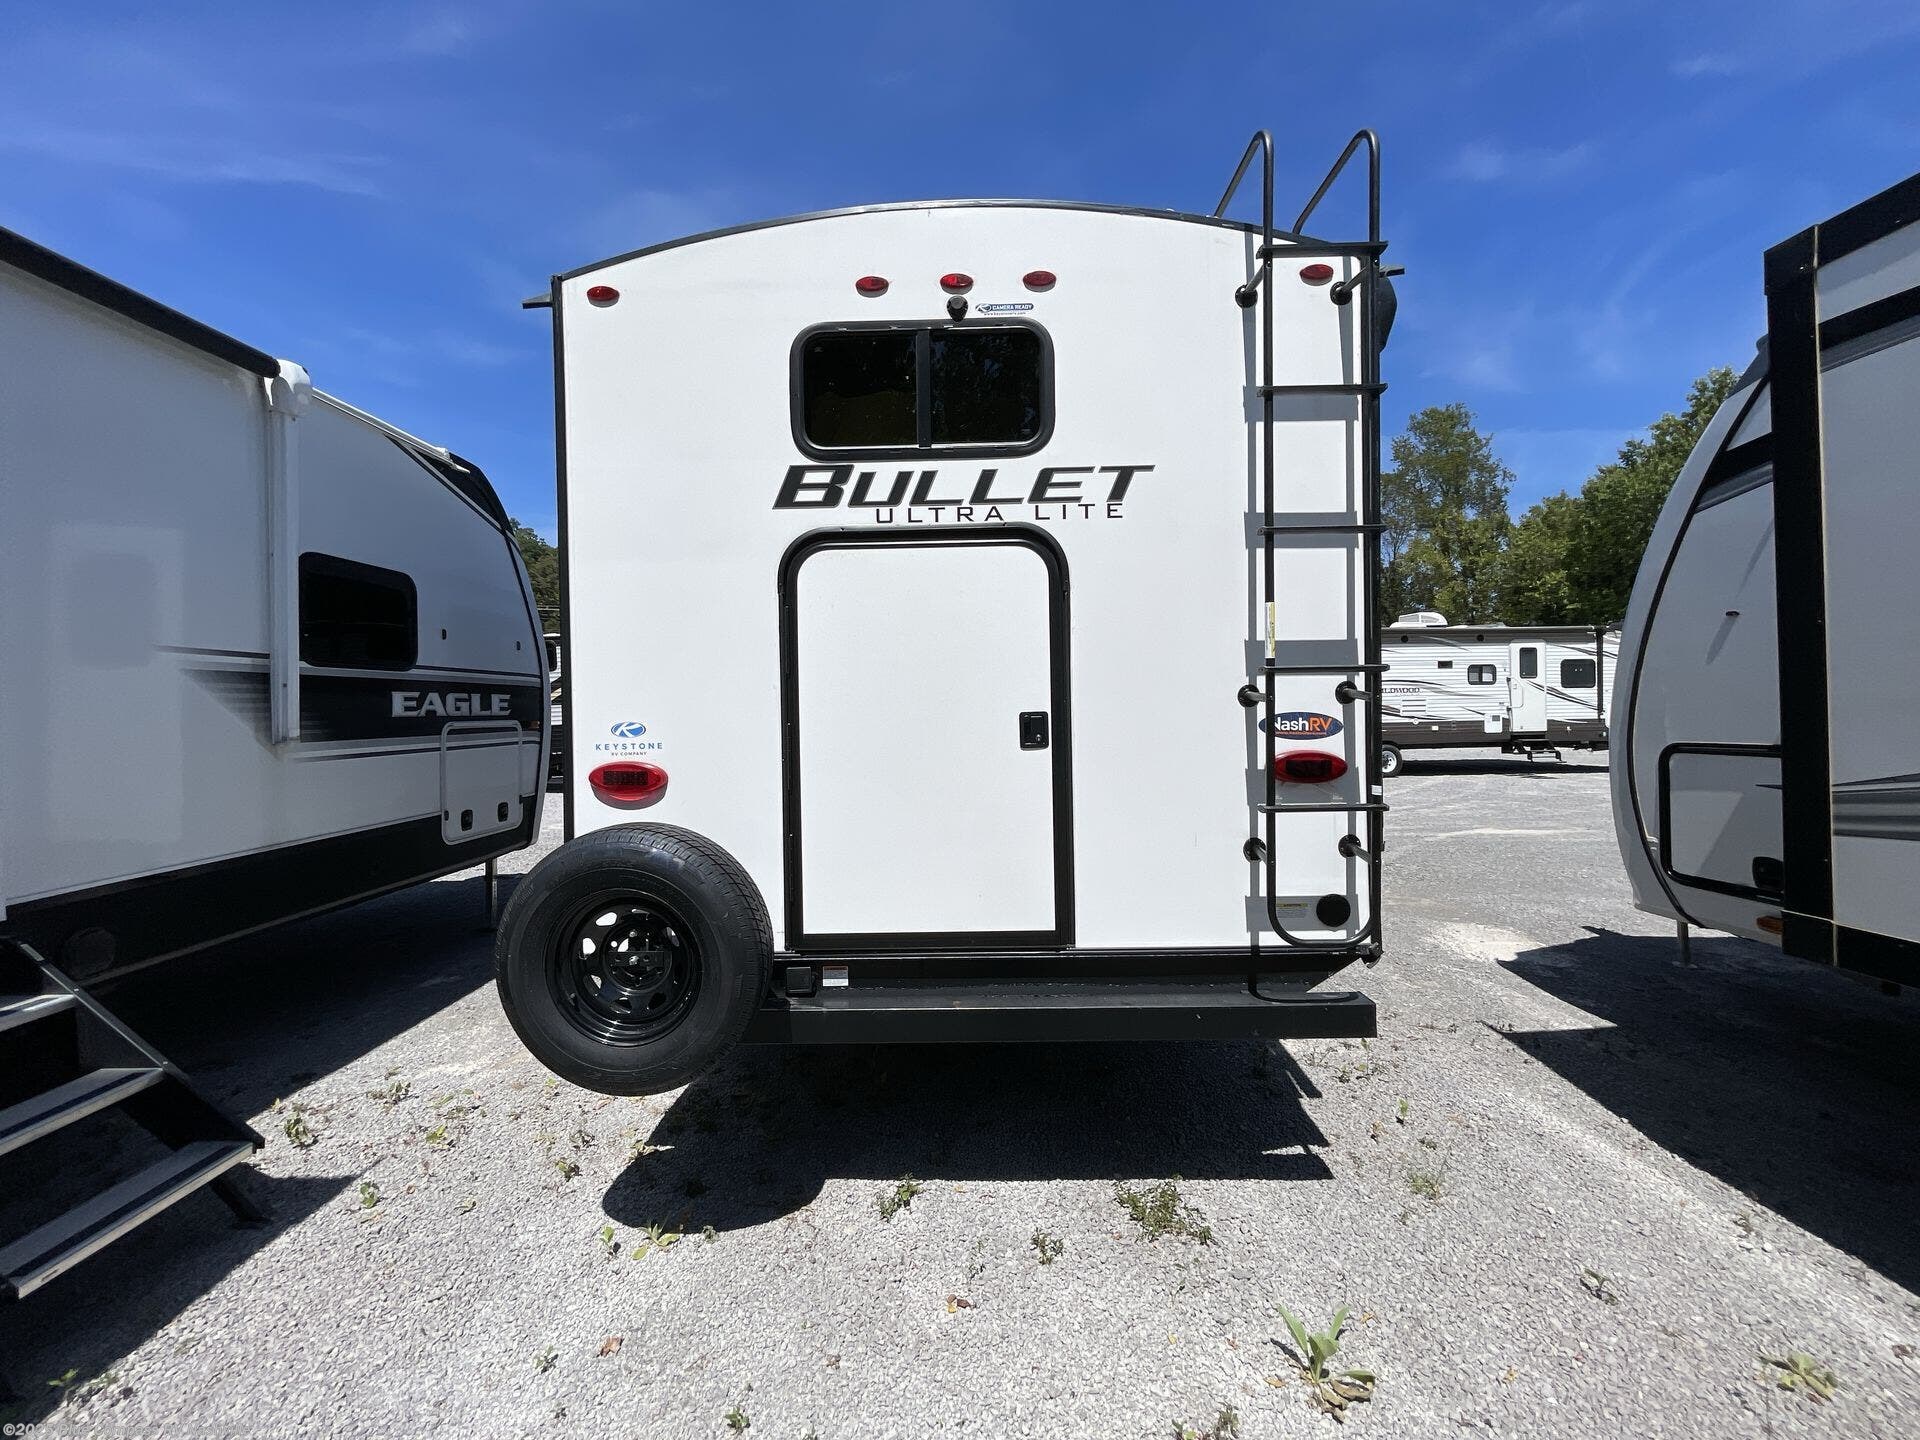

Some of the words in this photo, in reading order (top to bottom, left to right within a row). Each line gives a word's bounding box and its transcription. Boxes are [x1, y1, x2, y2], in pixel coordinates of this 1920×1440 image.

[772, 464, 1155, 510] BULLET
[876, 506, 1004, 524] ULTRA
[1035, 503, 1123, 520] LITE
[391, 691, 512, 718] EAGLE
[595, 742, 663, 751] KEYSTONE
